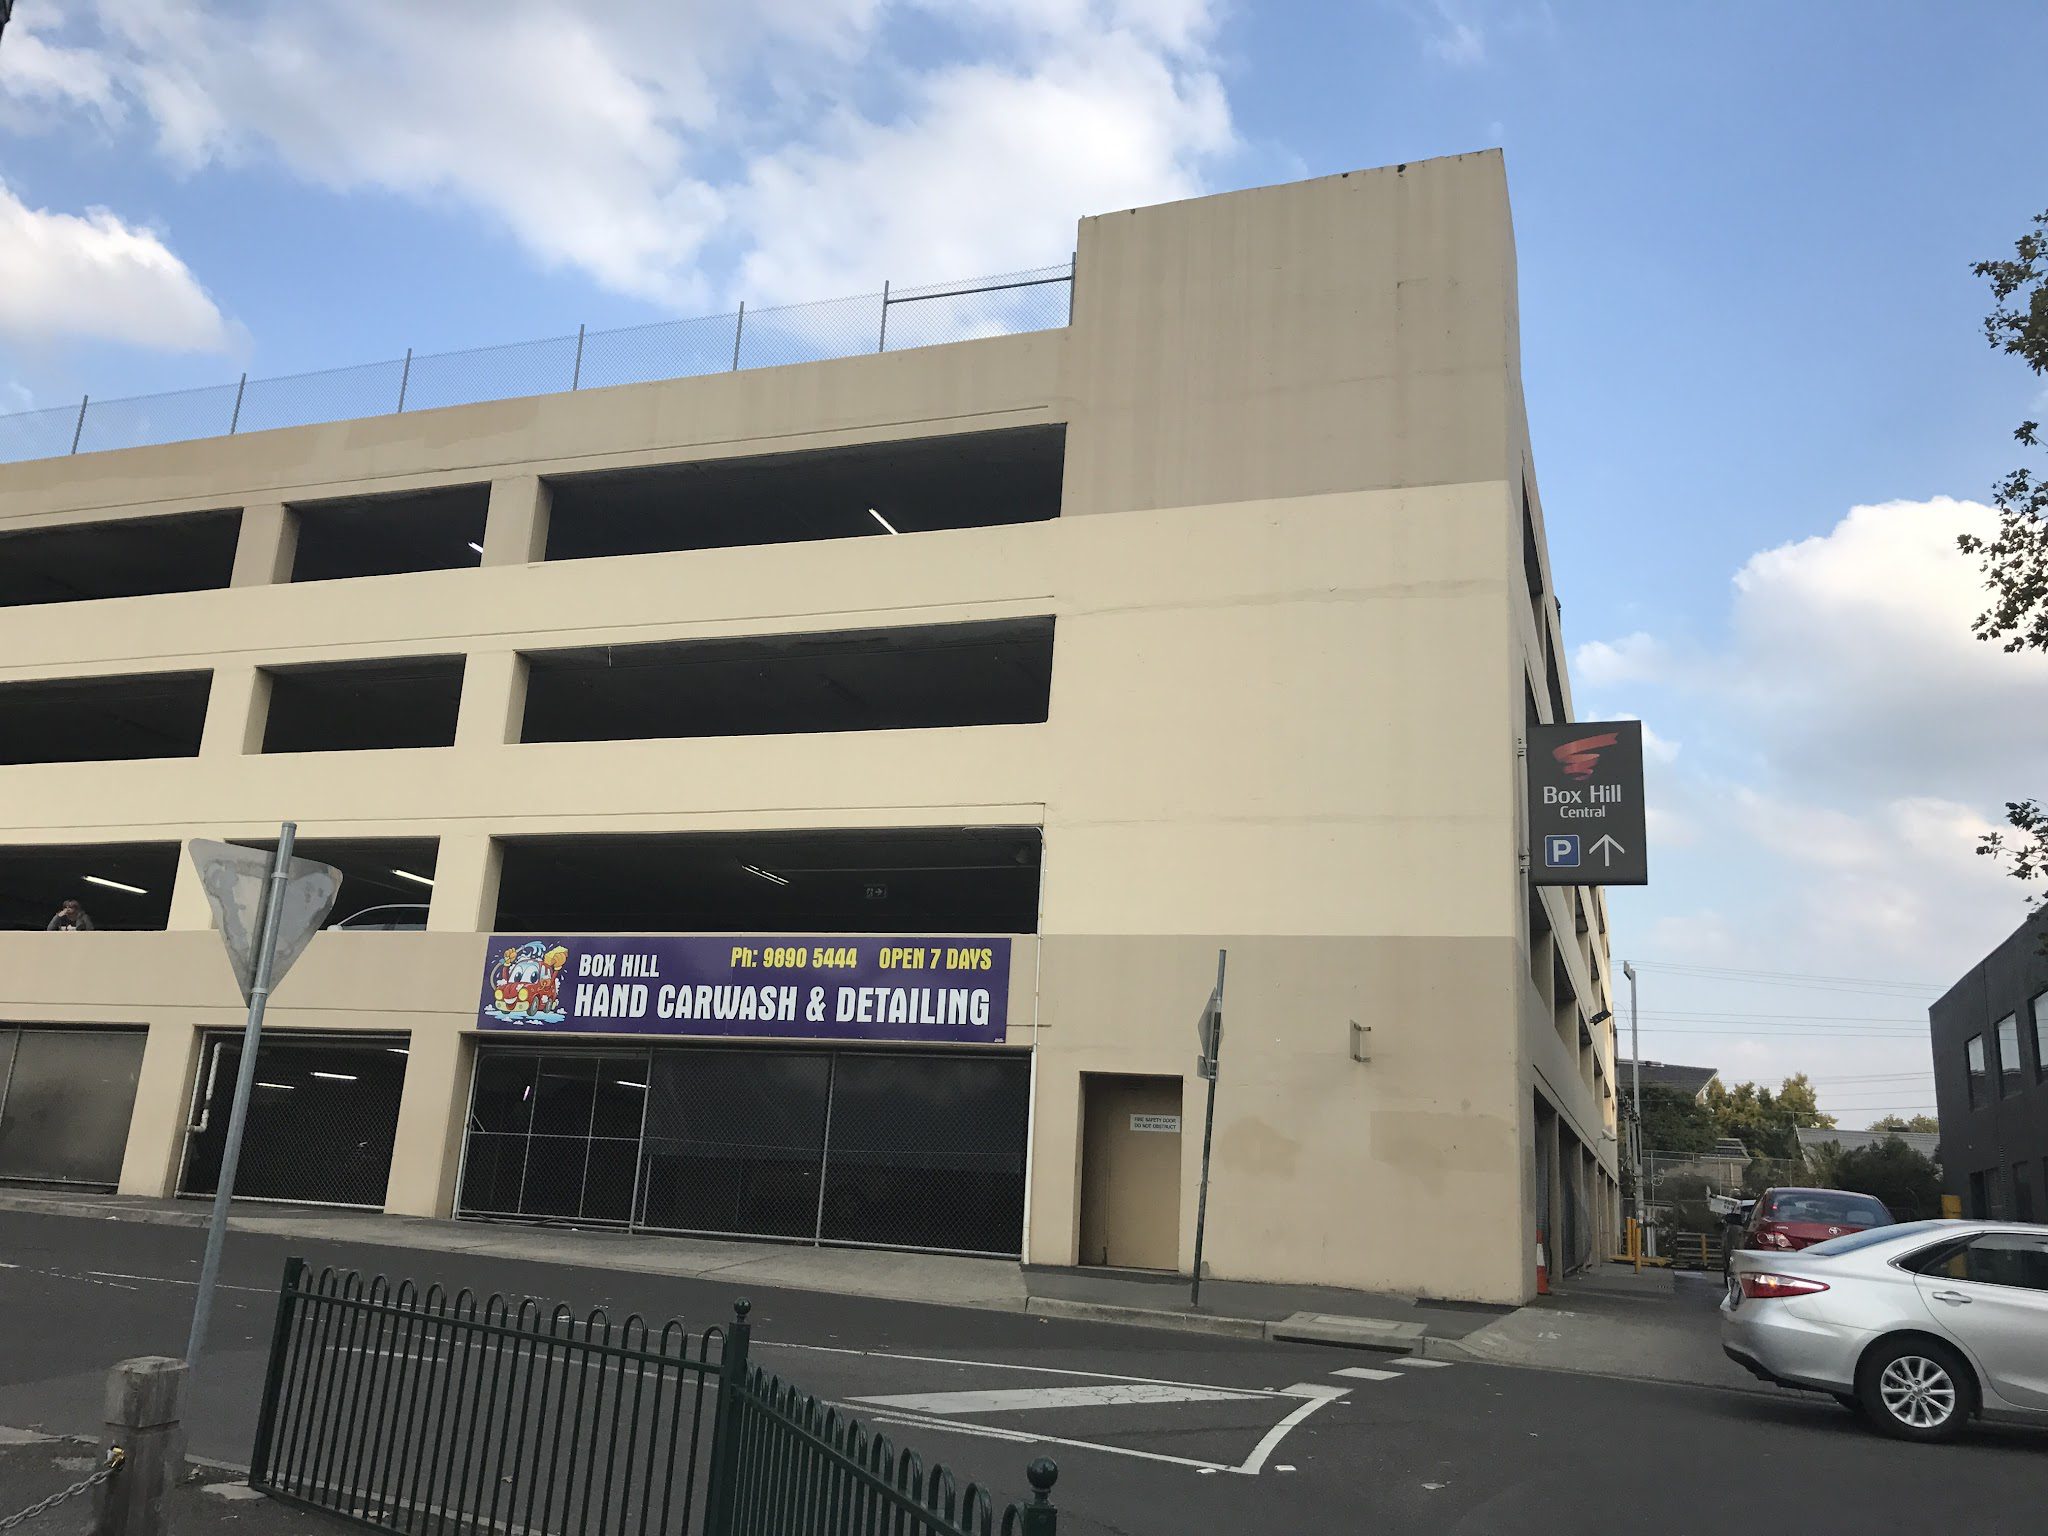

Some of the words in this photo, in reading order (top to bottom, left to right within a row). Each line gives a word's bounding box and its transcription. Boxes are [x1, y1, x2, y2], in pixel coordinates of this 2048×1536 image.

[1543, 786, 1582, 804] Box
[1590, 784, 1622, 803] Hill
[1560, 805, 1606, 818] Central
[1553, 839, 1572, 863] P
[578, 953, 616, 978] BOX
[620, 954, 660, 978] HILL
[730, 946, 758, 968] Ph:
[762, 947, 808, 968] 9890
[812, 947, 857, 969] 5444
[878, 947, 925, 970] OPEN
[929, 948, 941, 970] 7
[946, 948, 993, 970] DAYS
[574, 983, 650, 1018] HAND
[657, 984, 798, 1021] CARWASH
[805, 985, 827, 1022] &
[836, 986, 990, 1026] DETAILING
